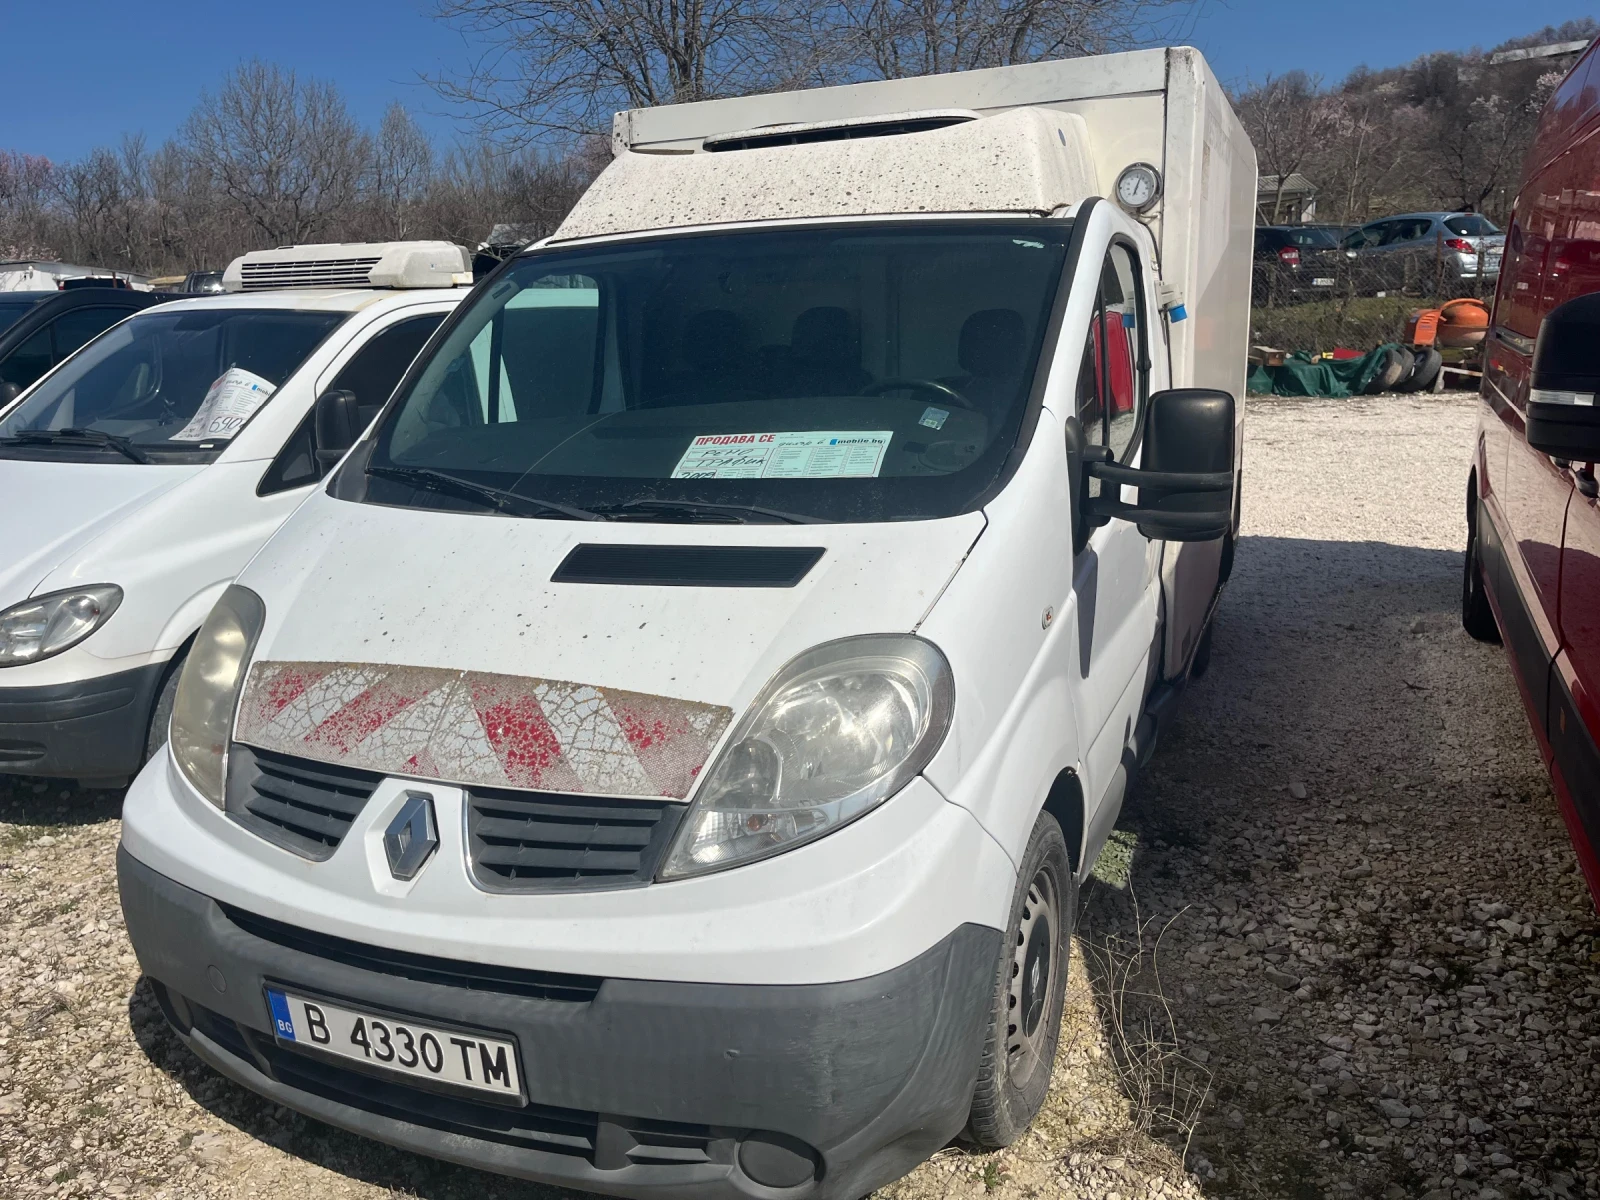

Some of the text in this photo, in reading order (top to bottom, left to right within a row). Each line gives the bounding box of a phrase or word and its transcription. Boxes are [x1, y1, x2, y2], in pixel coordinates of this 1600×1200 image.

[695, 434, 776, 446] ПРОДАВА СЕ
[277, 1019, 293, 1034] BG
[303, 1002, 512, 1088] B 4330 TM
